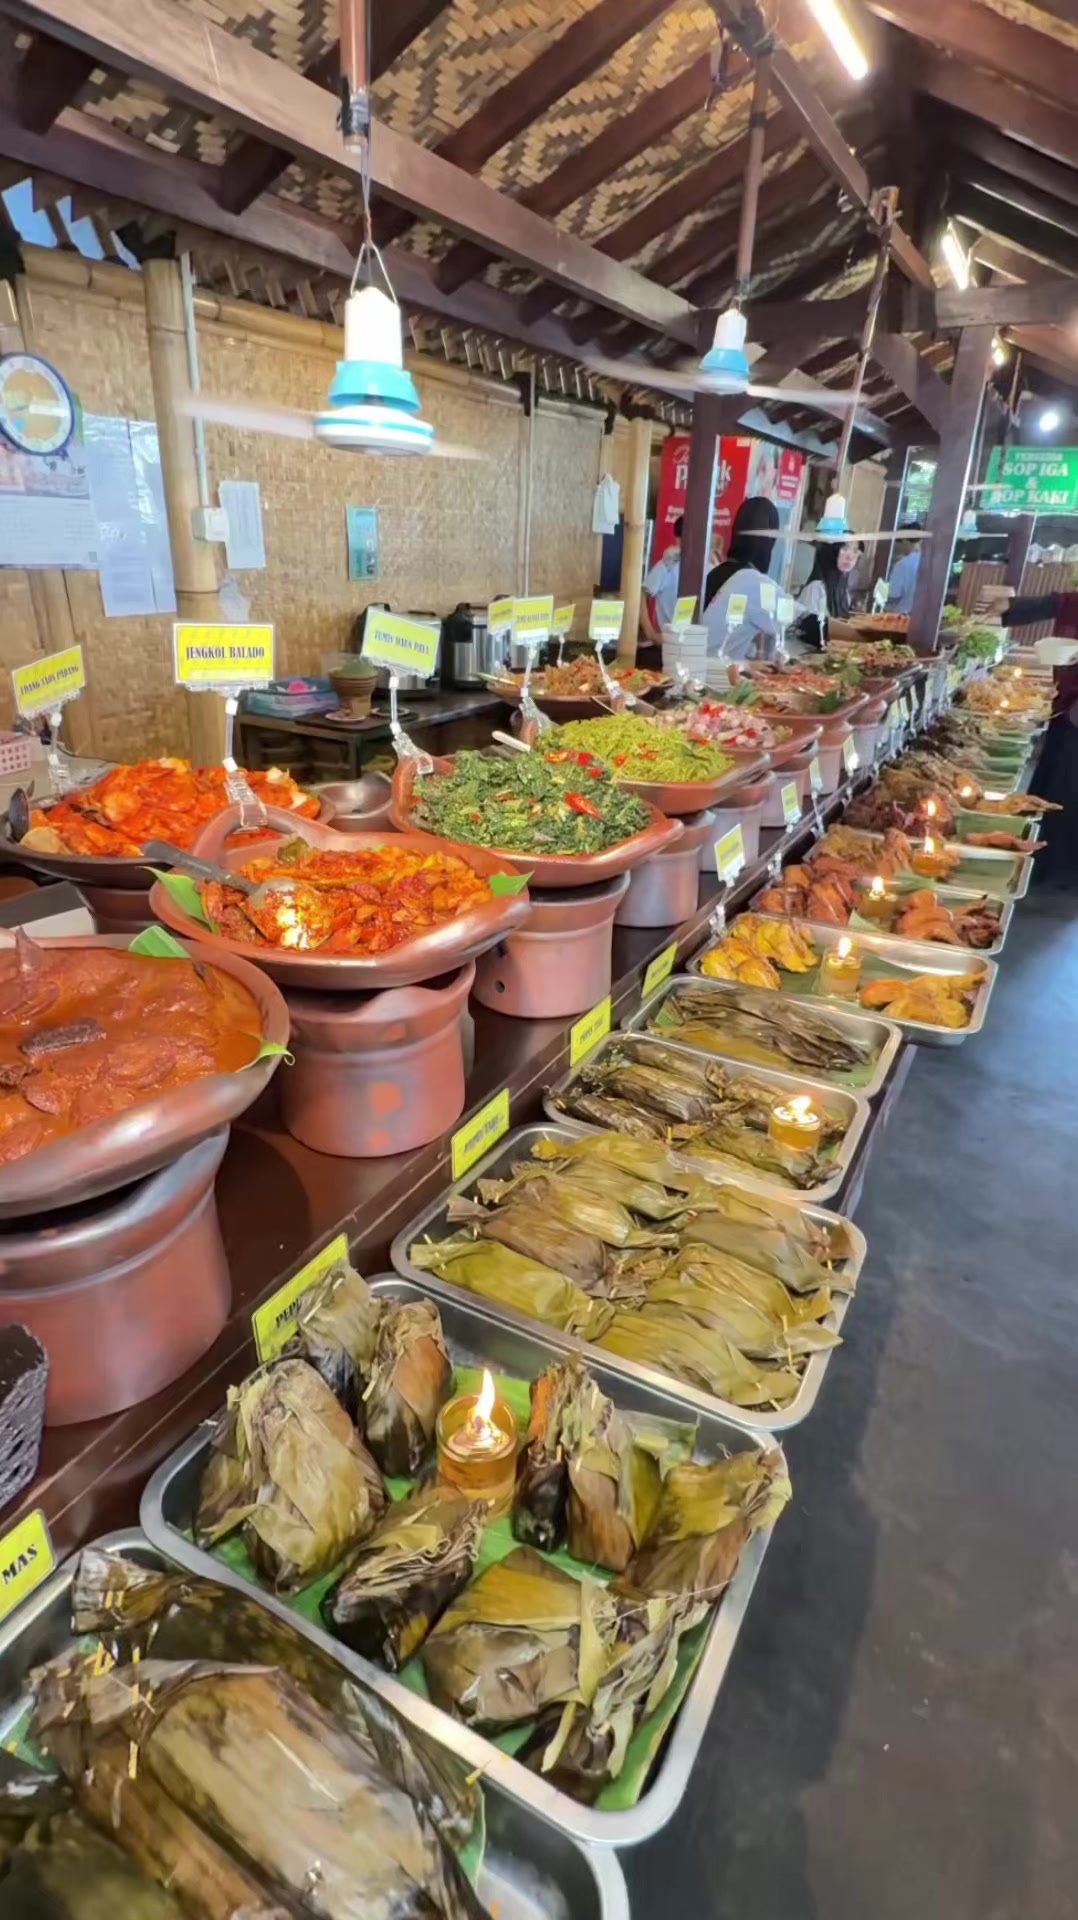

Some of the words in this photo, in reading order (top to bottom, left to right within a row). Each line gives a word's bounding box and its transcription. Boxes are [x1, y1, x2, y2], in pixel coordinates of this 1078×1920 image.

[1002, 462, 1037, 476] SOP
[1039, 462, 1069, 476] IGA
[1027, 489, 1069, 504] KAKI
[186, 646, 225, 660] JENGKOL
[229, 646, 265, 659] BALADO
[1, 1543, 39, 1585] MAS
